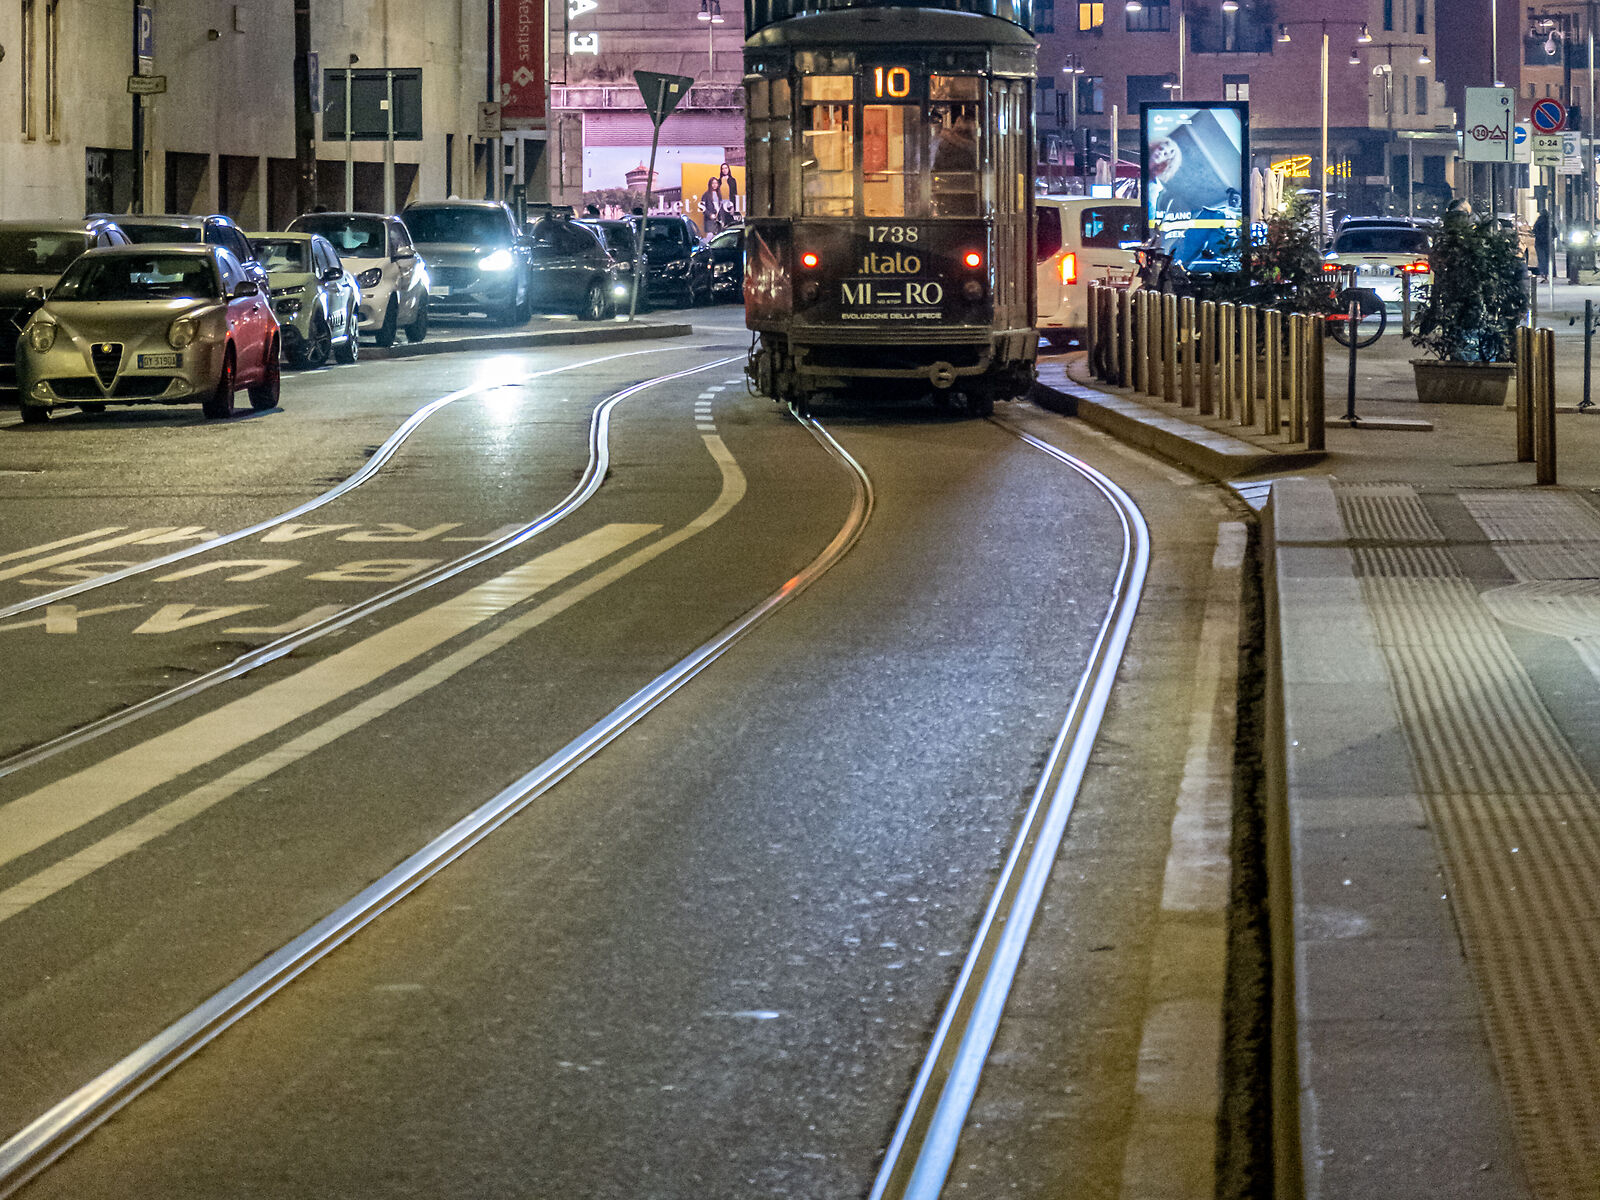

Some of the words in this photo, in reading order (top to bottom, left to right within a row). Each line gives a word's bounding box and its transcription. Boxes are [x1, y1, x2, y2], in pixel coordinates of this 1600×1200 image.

[141, 13, 150, 51] P
[874, 66, 910, 98] 10
[1539, 139, 1558, 147] 0-24
[657, 194, 707, 213] Let's
[869, 226, 918, 243] 1738
[841, 283, 871, 304] MI
[906, 282, 943, 305] RO
[916, 312, 943, 320] SPECIE
